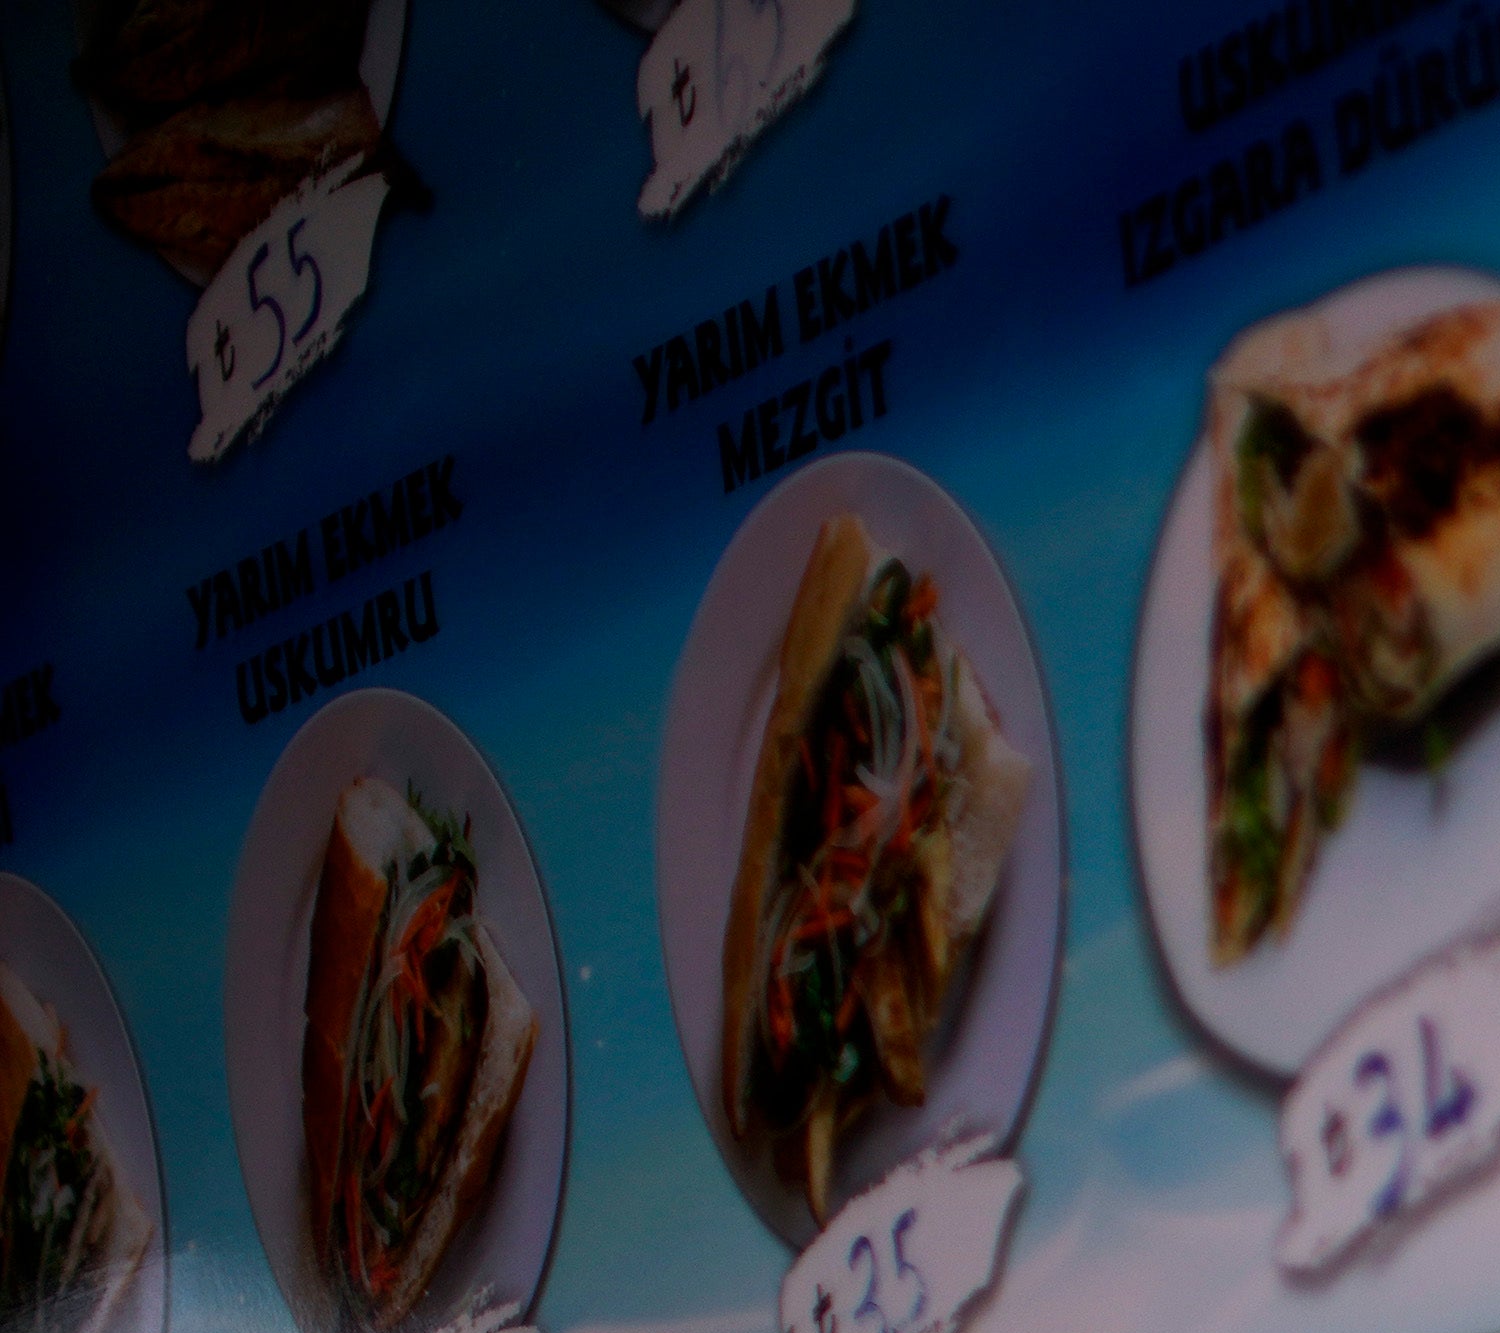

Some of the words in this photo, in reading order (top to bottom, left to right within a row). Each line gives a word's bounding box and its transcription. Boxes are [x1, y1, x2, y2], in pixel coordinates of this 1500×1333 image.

[1179, 0, 1452, 133] USKUM
[1119, 120, 1322, 287] IZGARA
[631, 285, 784, 427] YARIM
[793, 194, 960, 343] EKMEK
[717, 337, 895, 494] MEZGİT
[187, 528, 314, 649] YARIM
[320, 456, 464, 583] EKMEK
[235, 571, 440, 725] USKUMRU
